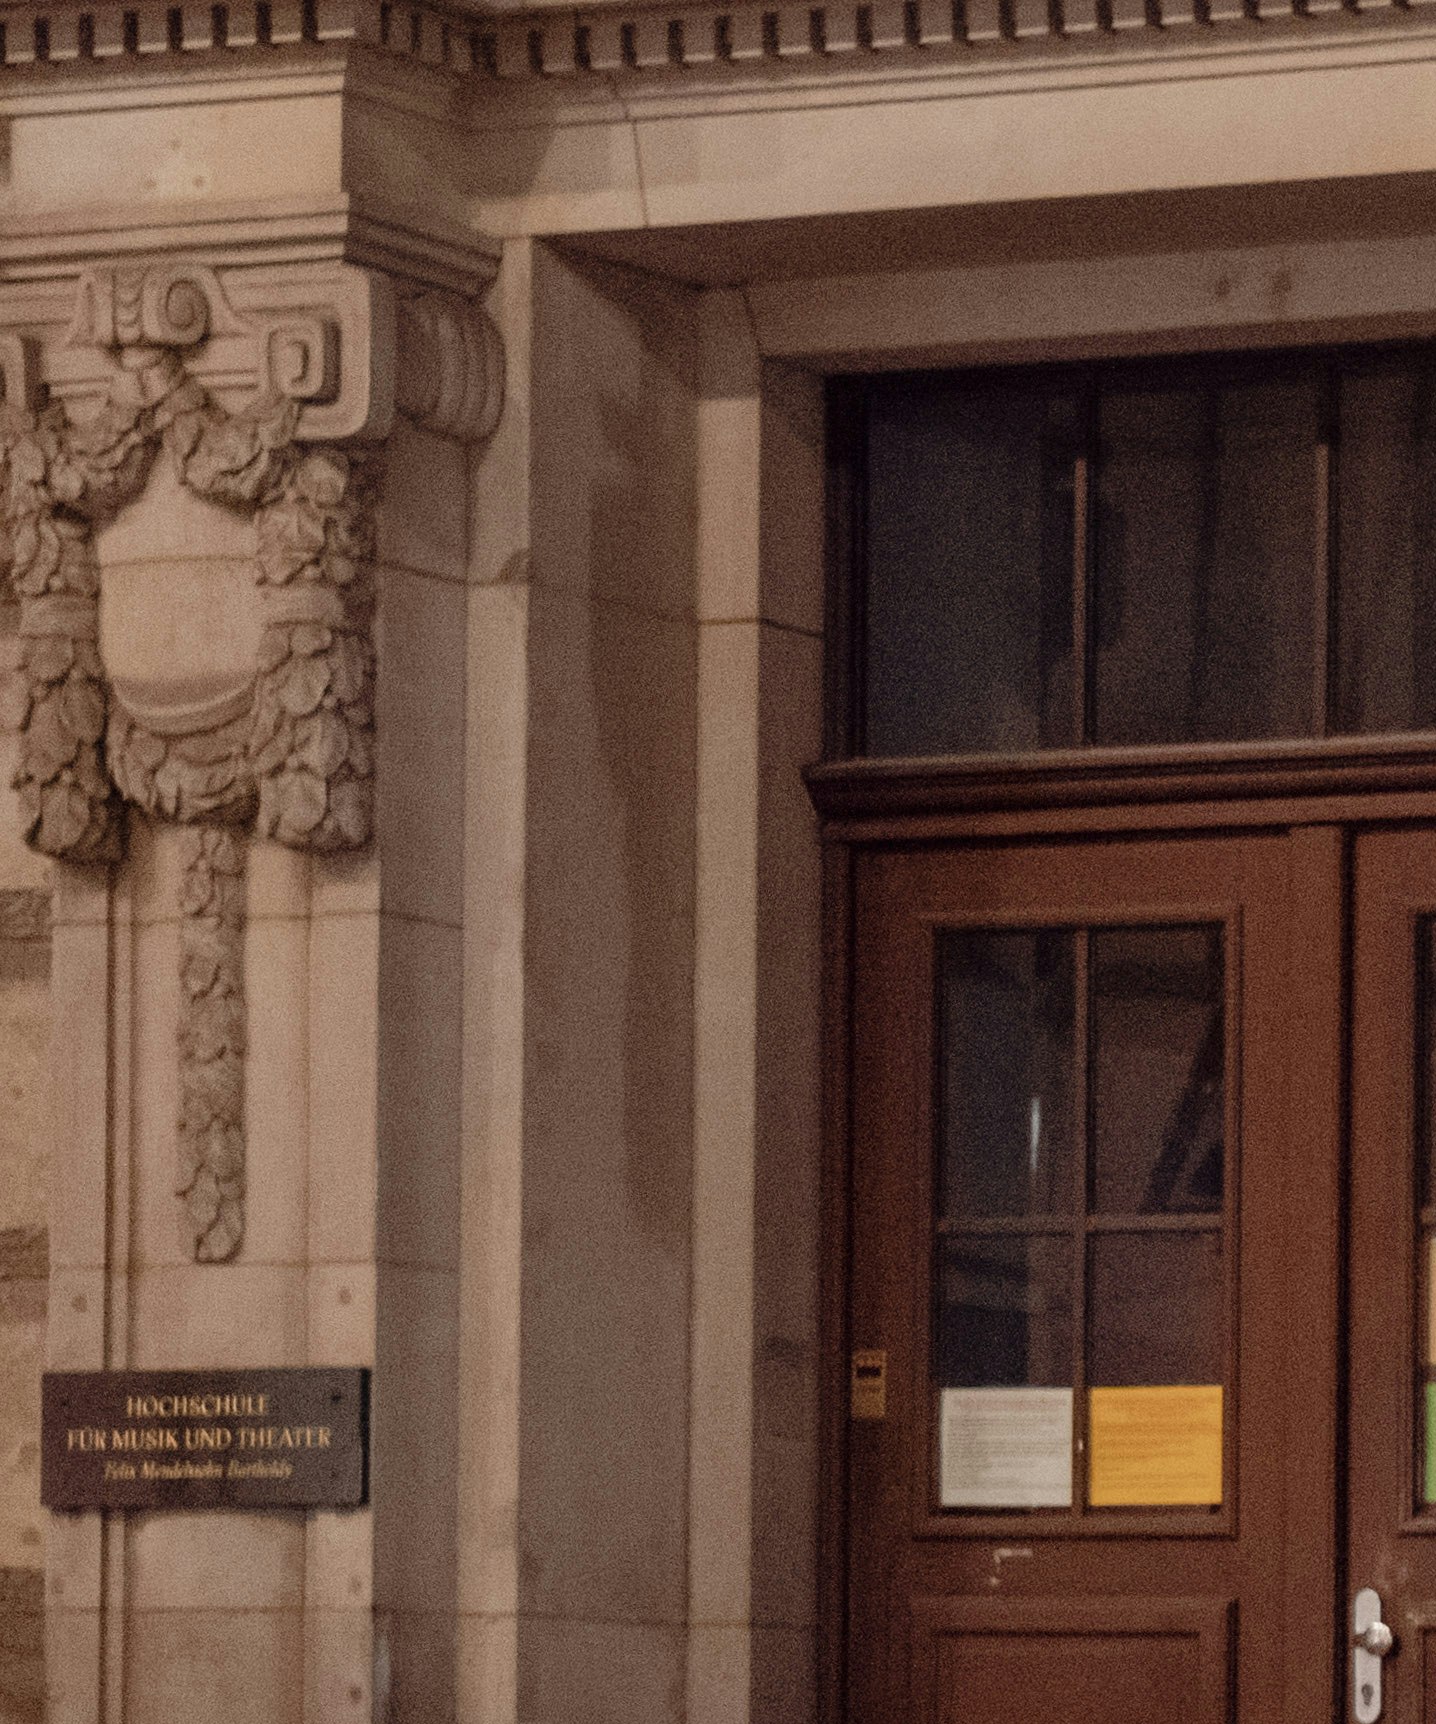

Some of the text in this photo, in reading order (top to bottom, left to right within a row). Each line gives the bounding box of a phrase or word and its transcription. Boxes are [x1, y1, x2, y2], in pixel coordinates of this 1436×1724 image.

[126, 1394, 268, 1417] HOCHSCHULE
[67, 1426, 331, 1451] FÜR MUSIK UND THEATER
